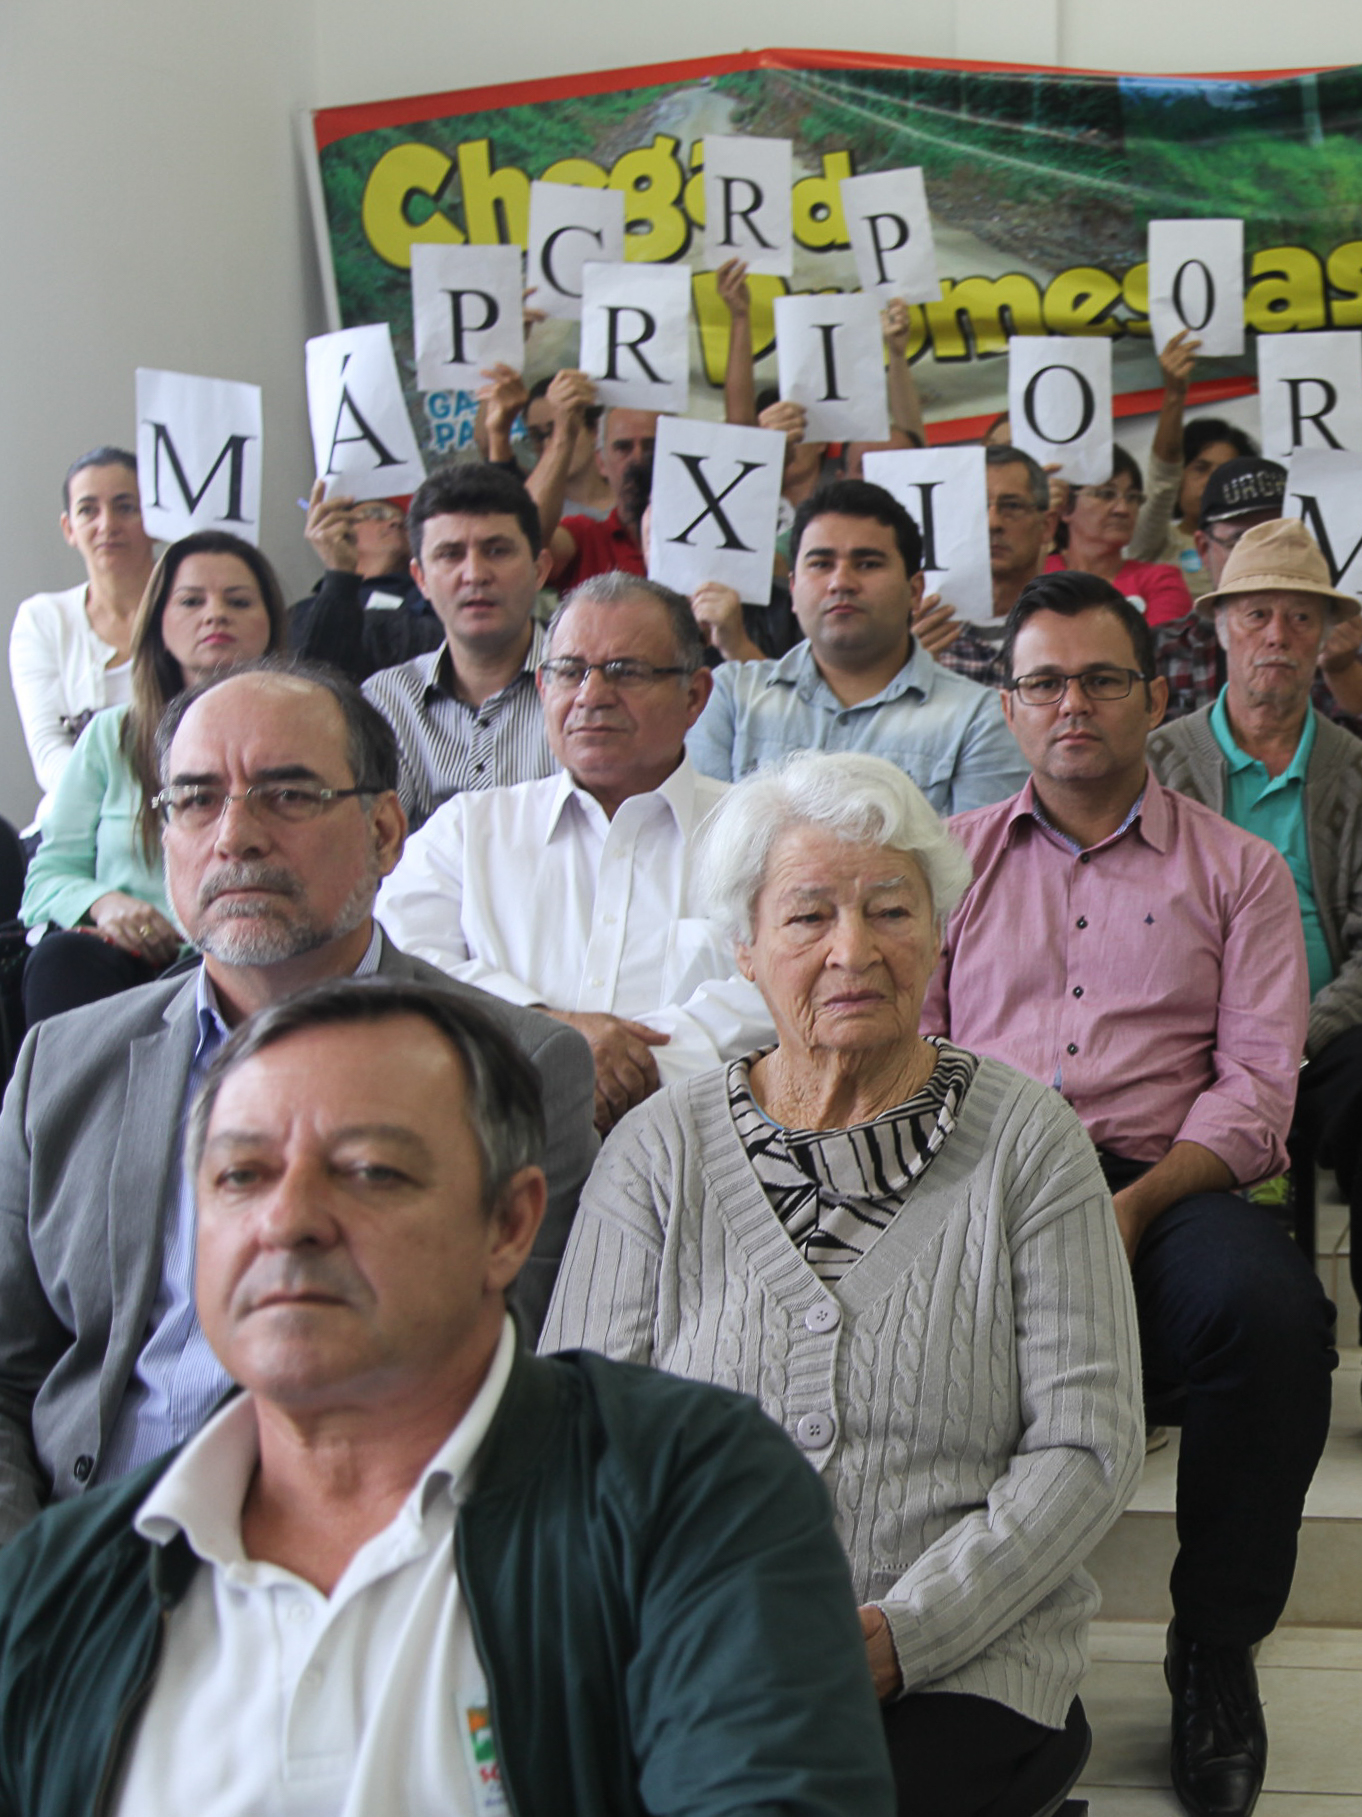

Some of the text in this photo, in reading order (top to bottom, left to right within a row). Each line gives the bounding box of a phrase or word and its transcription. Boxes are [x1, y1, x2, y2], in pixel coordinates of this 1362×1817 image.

[716, 176, 779, 249] R
[861, 213, 909, 286] P
[541, 225, 604, 299] C
[440, 288, 500, 364] P
[601, 305, 674, 385] R
[809, 323, 844, 402] I
[321, 353, 409, 475] Á
[1022, 364, 1096, 445] O
[1279, 378, 1348, 457] R
[142, 420, 257, 524] M
[666, 452, 767, 552] X
[908, 481, 950, 571] I
